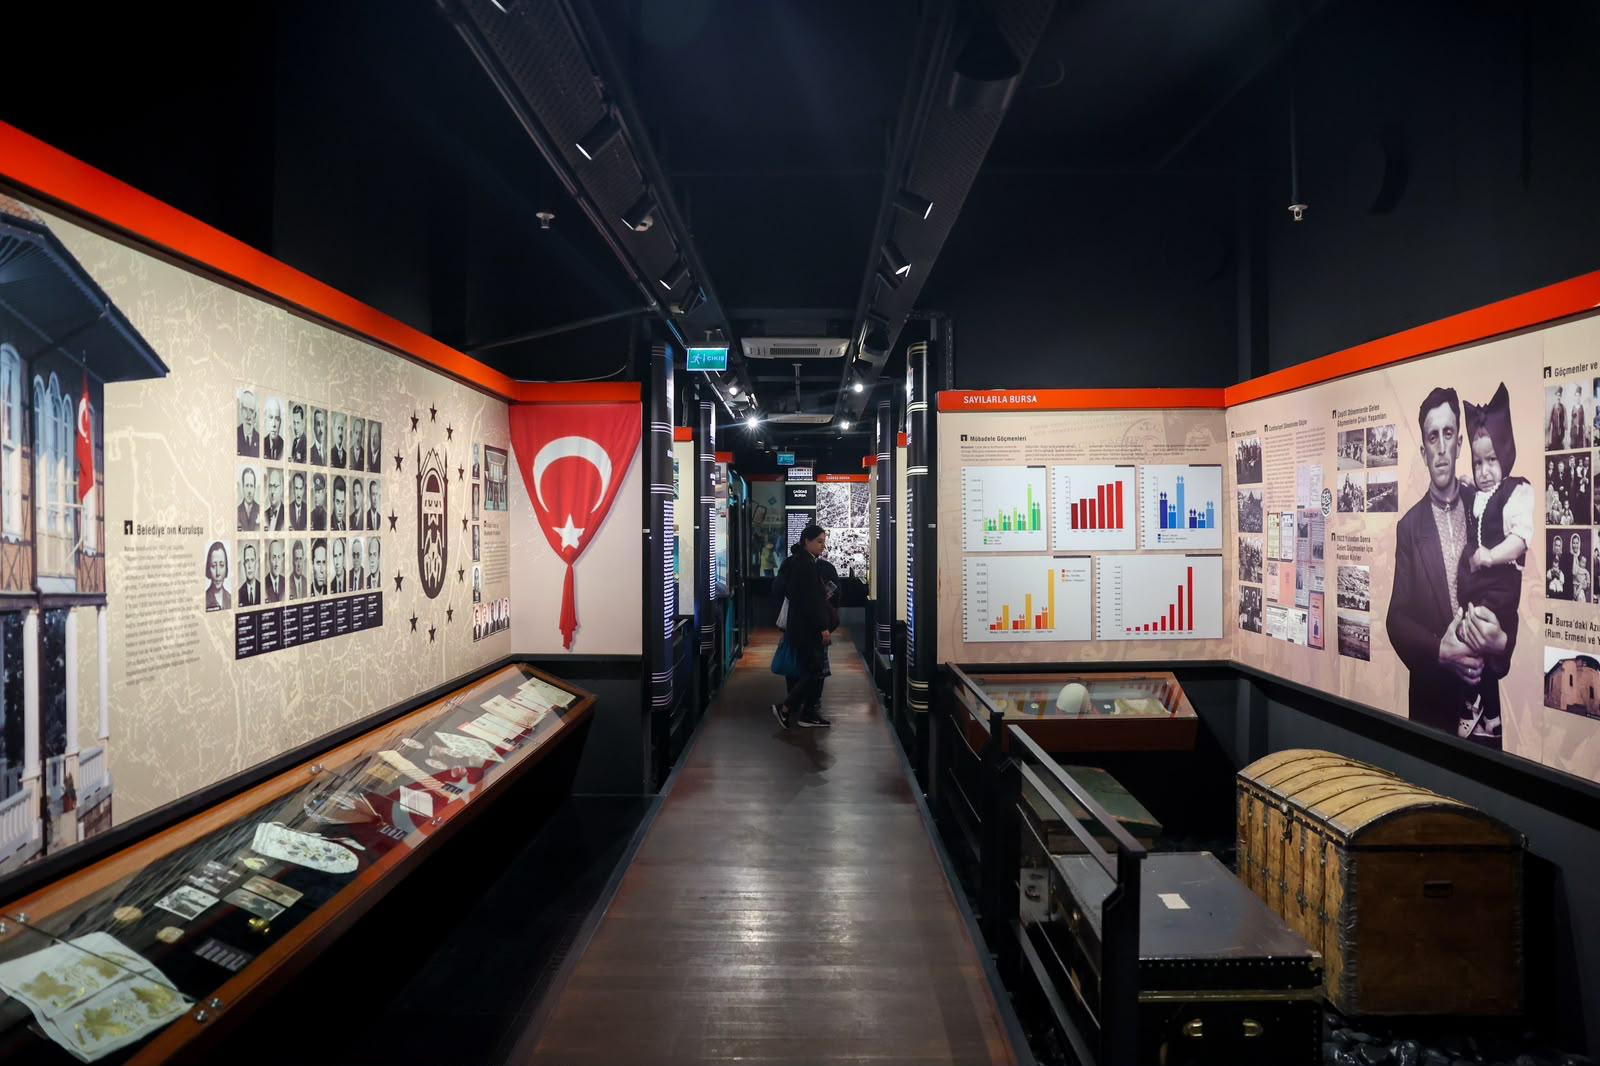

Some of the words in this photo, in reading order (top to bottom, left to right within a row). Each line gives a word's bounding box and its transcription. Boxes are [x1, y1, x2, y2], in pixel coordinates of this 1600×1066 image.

[1554, 363, 1588, 377] Göçmenler
[1590, 361, 1598, 370] ve
[963, 395, 1008, 404] SAYILARLA
[1009, 395, 1037, 404] BURSA
[997, 434, 1027, 442] Göçmenleri
[1556, 617, 1588, 631] Bursa'daki
[1564, 631, 1587, 644] Ermeni
[1588, 635, 1596, 645] ve
